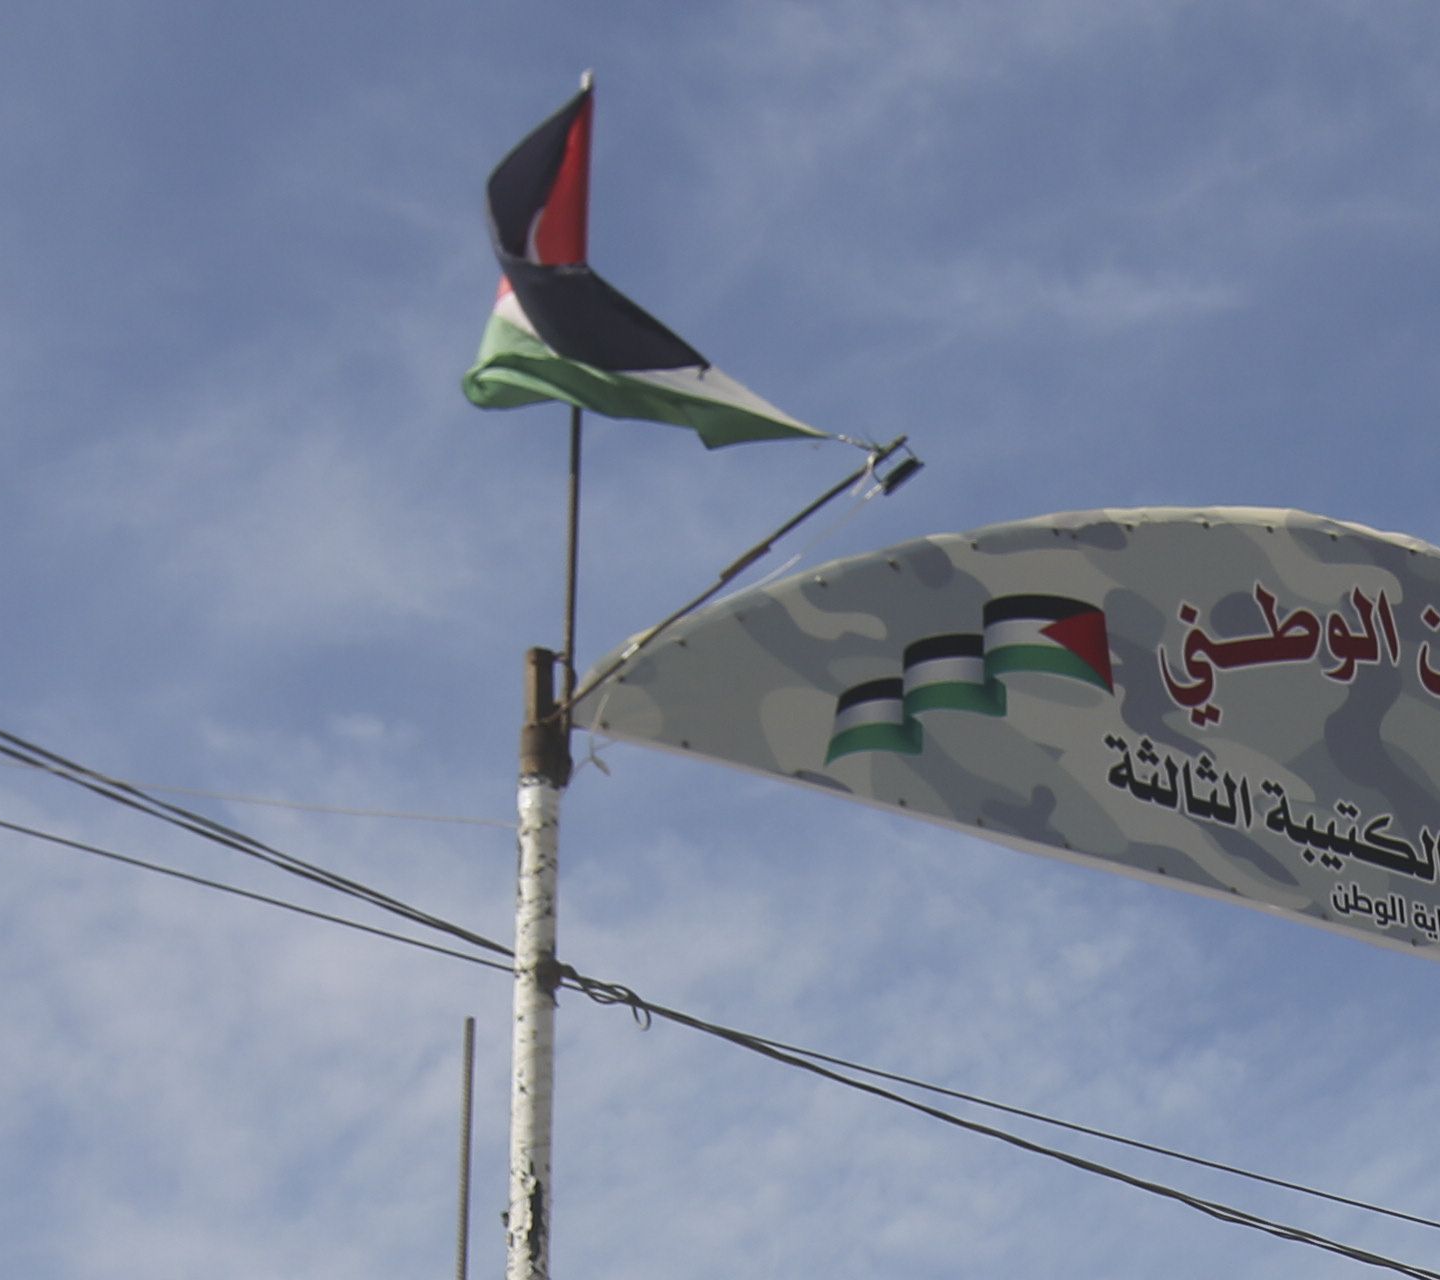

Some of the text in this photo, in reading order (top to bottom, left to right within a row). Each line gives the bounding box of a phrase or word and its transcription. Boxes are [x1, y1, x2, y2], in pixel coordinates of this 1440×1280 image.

[1160, 583, 1399, 726] الوطني
[1104, 733, 1253, 828] الثالثة
[1332, 885, 1405, 925] الوطن
